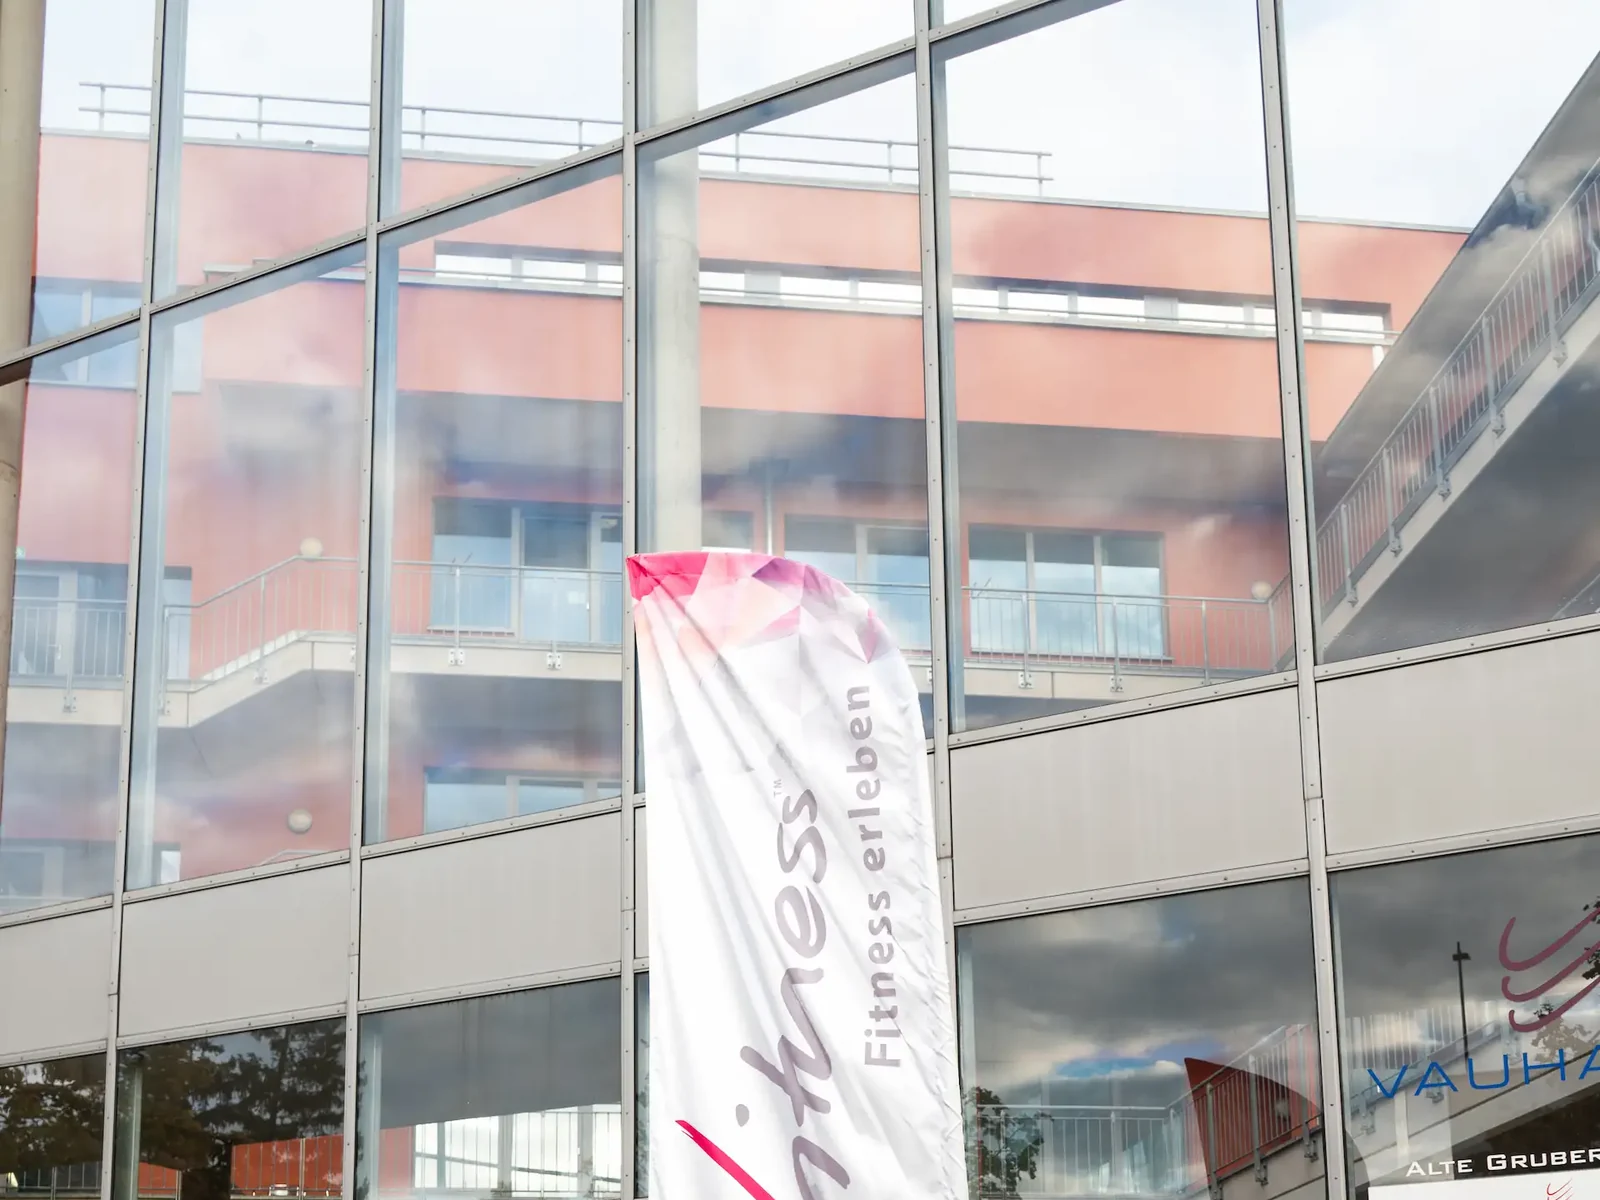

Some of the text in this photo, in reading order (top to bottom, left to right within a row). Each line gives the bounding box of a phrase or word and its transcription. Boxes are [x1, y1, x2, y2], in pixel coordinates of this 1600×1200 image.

[846, 685, 901, 1067] Fitness erleben
[1405, 1148, 1600, 1177] ALTE GRUBER
